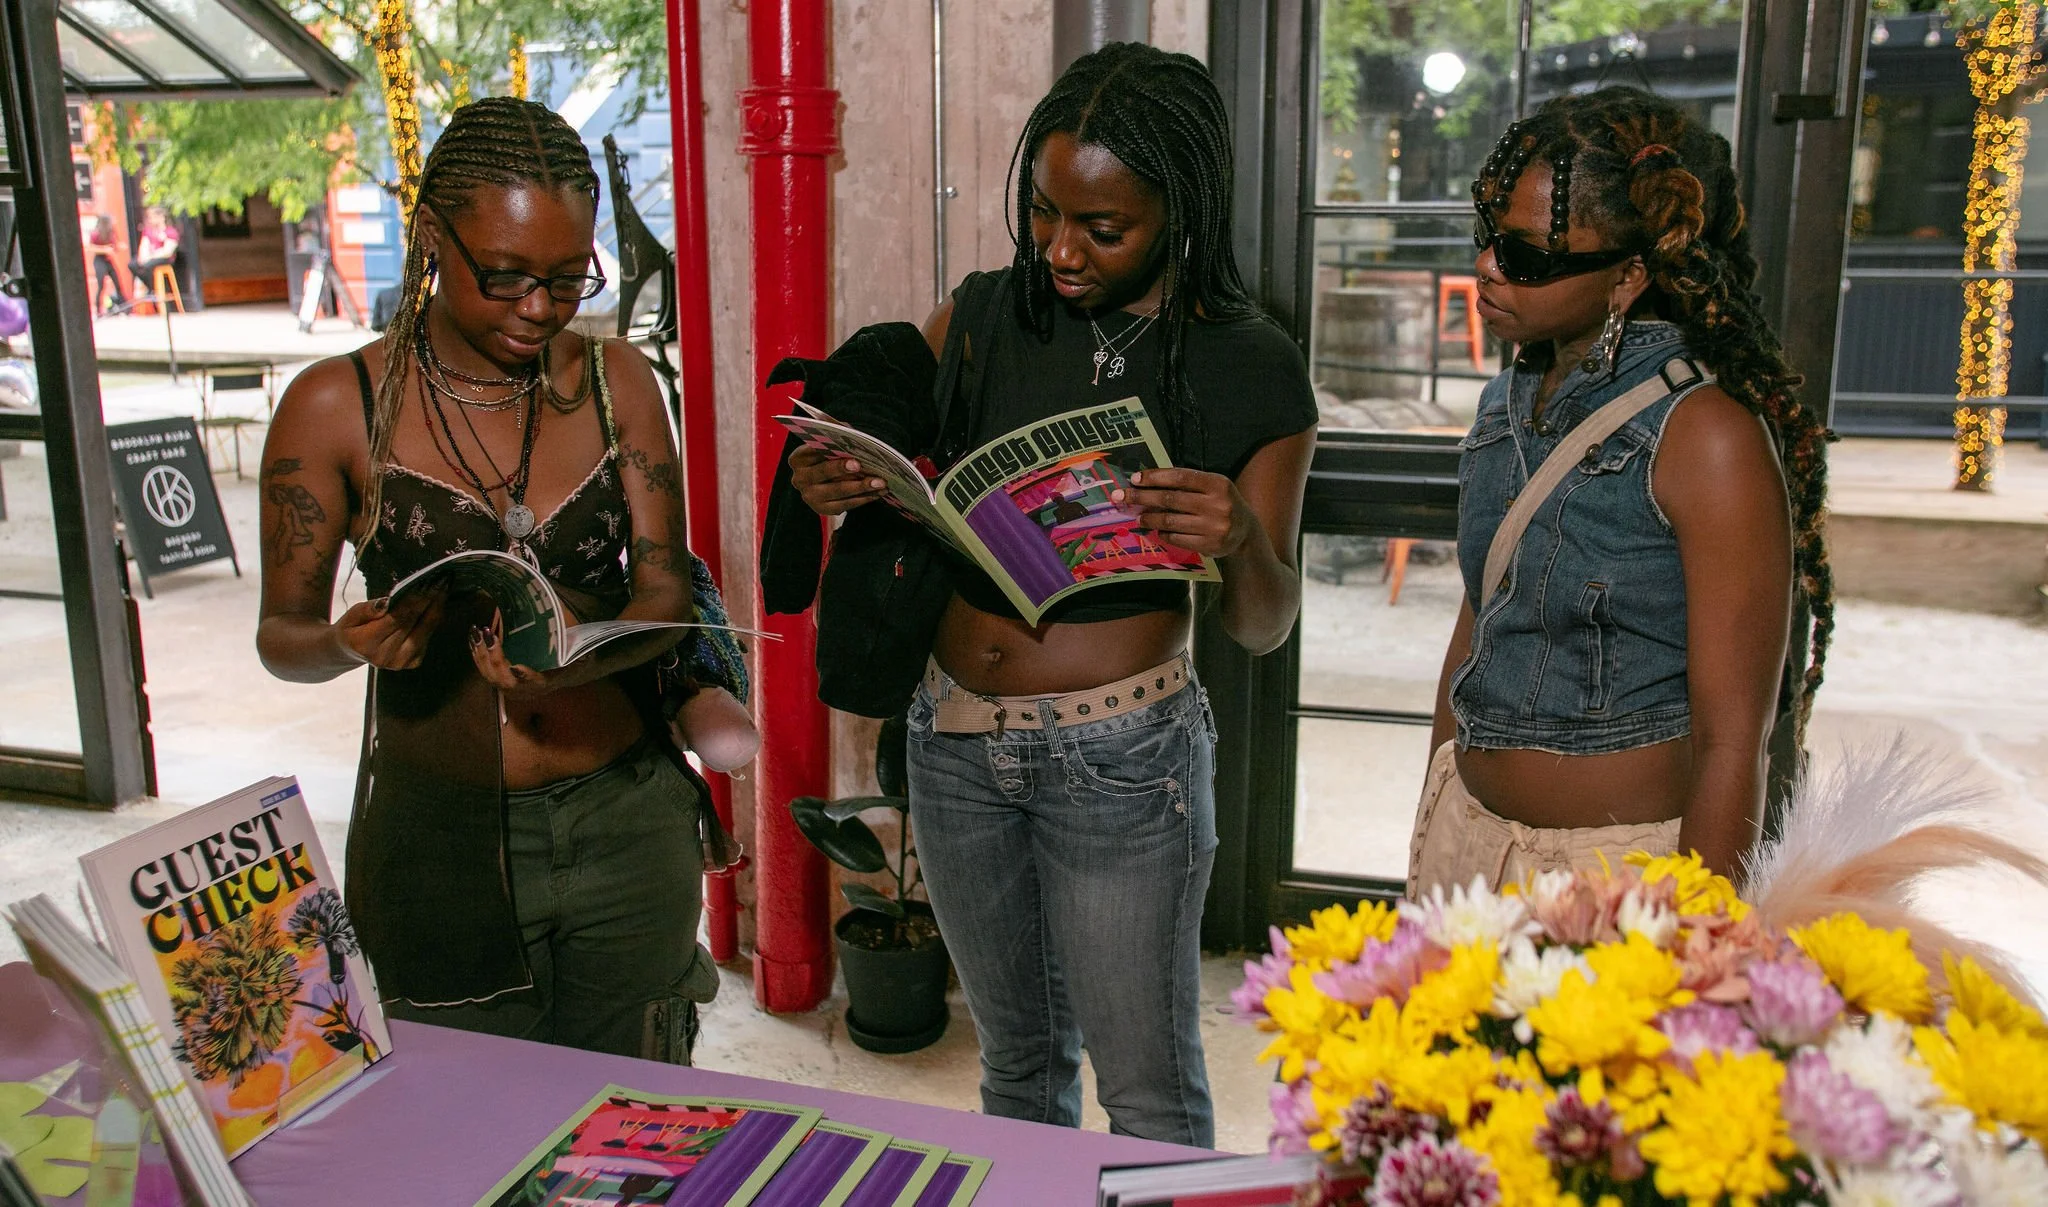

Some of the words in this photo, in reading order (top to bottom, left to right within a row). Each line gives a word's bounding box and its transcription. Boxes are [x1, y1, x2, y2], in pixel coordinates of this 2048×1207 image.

[110, 433, 163, 451] BROOKLYN
[126, 449, 158, 465] CRAFT
[1030, 406, 1142, 460] CHECK
[130, 807, 285, 909] GUEST
[147, 842, 317, 953] CHECK
